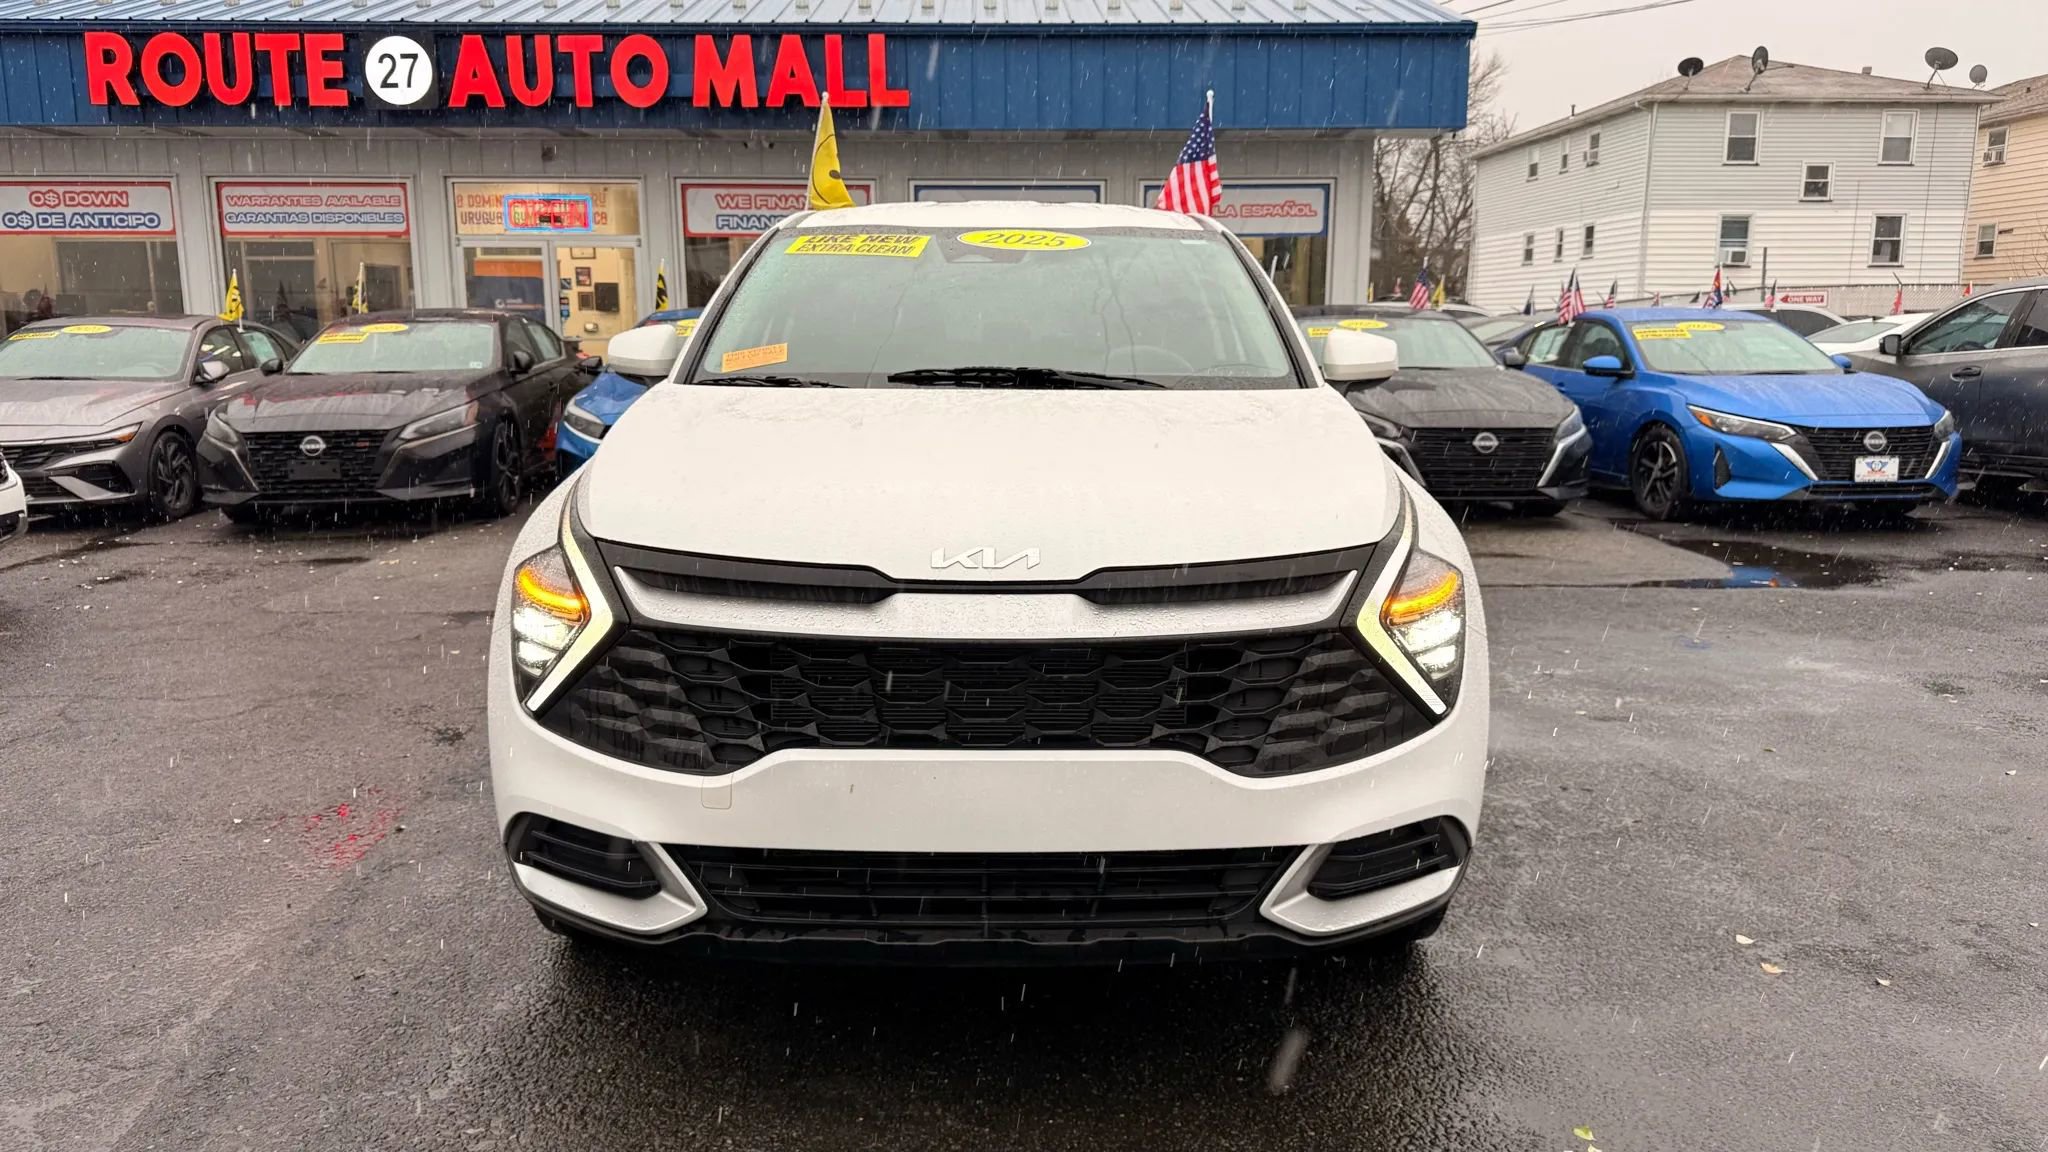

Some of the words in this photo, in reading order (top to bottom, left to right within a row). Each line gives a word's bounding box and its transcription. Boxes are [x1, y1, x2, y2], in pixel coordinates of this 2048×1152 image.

[84, 32, 349, 107] ROUTE
[377, 53, 419, 89] 27
[448, 33, 670, 108] AUTO
[692, 33, 910, 108] MALL
[63, 190, 129, 208] DOWN
[226, 194, 323, 207] WARRANTIES
[325, 194, 403, 207] AVAILABLE
[715, 194, 750, 209] WE
[753, 194, 809, 209] FINAN
[1240, 200, 1317, 217] ESPAÑOL
[36, 212, 66, 228] DE
[68, 212, 160, 229] ANTICIPO
[224, 211, 310, 224] GARANTIAS
[311, 211, 406, 224] DISPONIBLES
[860, 236, 919, 244] NEW
[979, 233, 1069, 247] 2025
[796, 244, 852, 252] EXTRA
[855, 244, 915, 254] CLEAN
